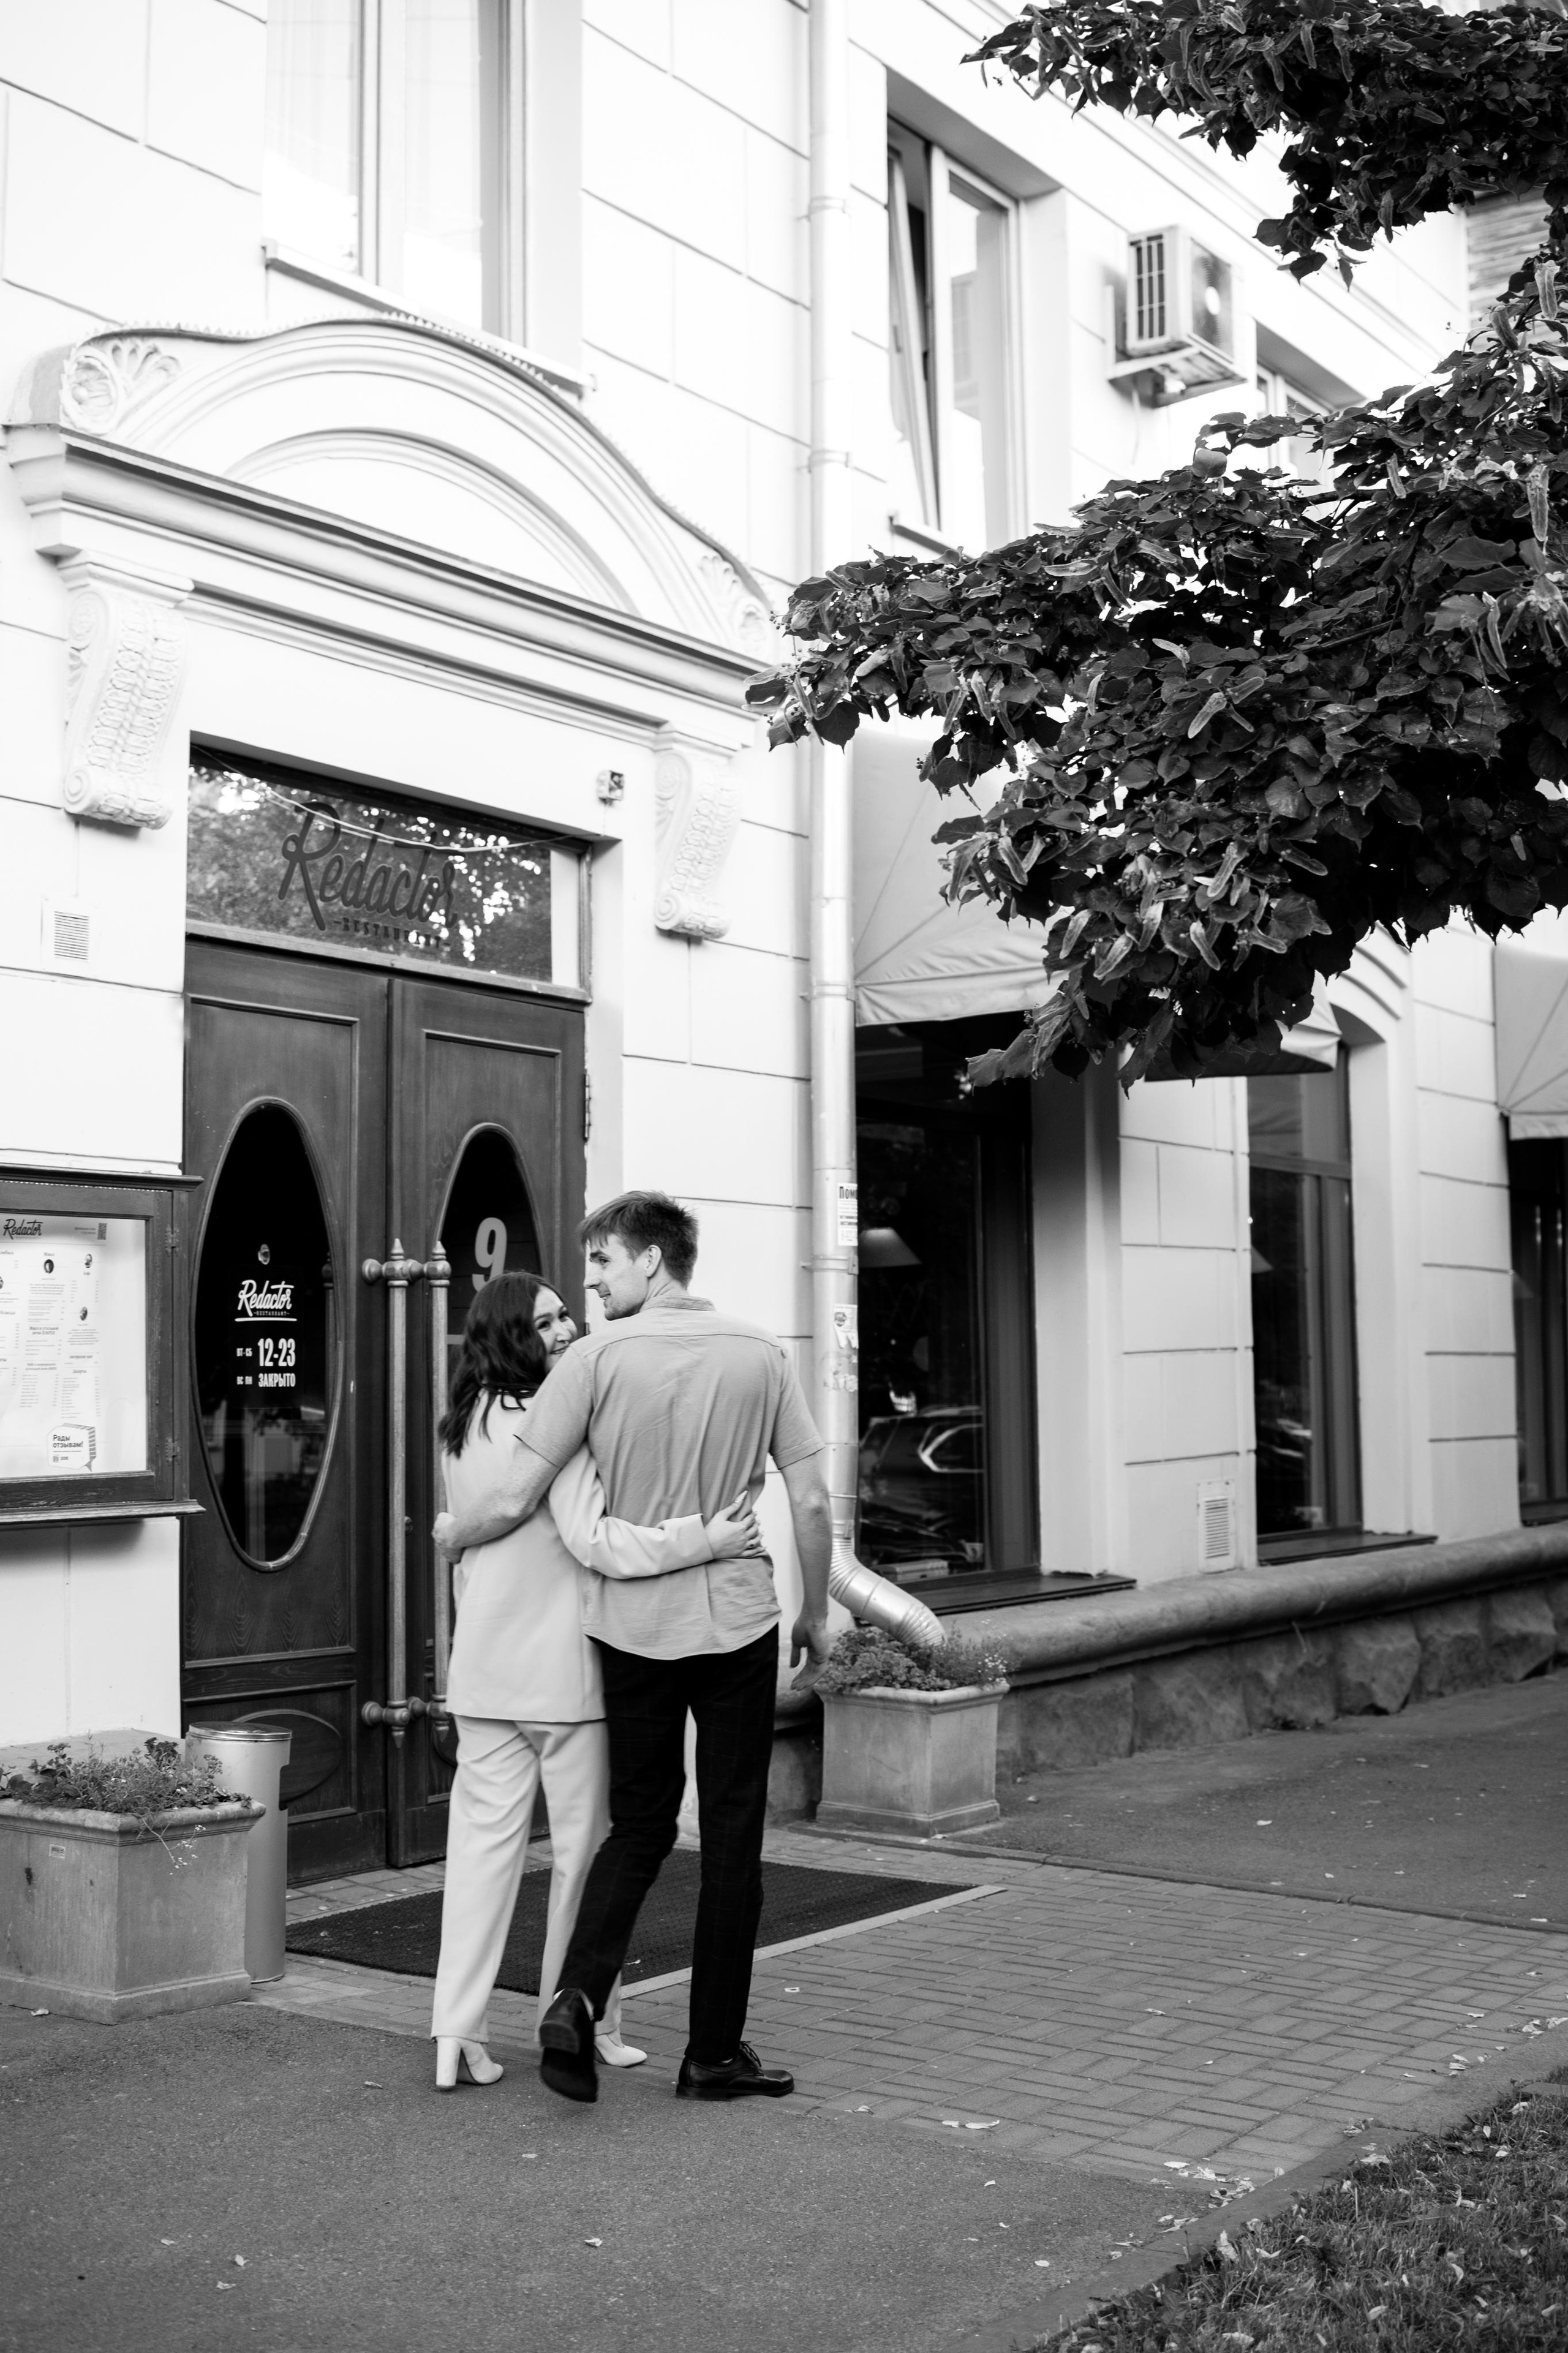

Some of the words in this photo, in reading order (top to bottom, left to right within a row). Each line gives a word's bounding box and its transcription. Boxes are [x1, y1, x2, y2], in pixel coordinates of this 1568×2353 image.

[278, 802, 466, 932] Redactor
[3, 1218, 43, 1240] Redactor
[472, 1217, 507, 1292] 9
[238, 1279, 295, 1317] Redactor
[257, 1338, 296, 1366] 12-23
[258, 1373, 296, 1387] ЗАКРЫТО
